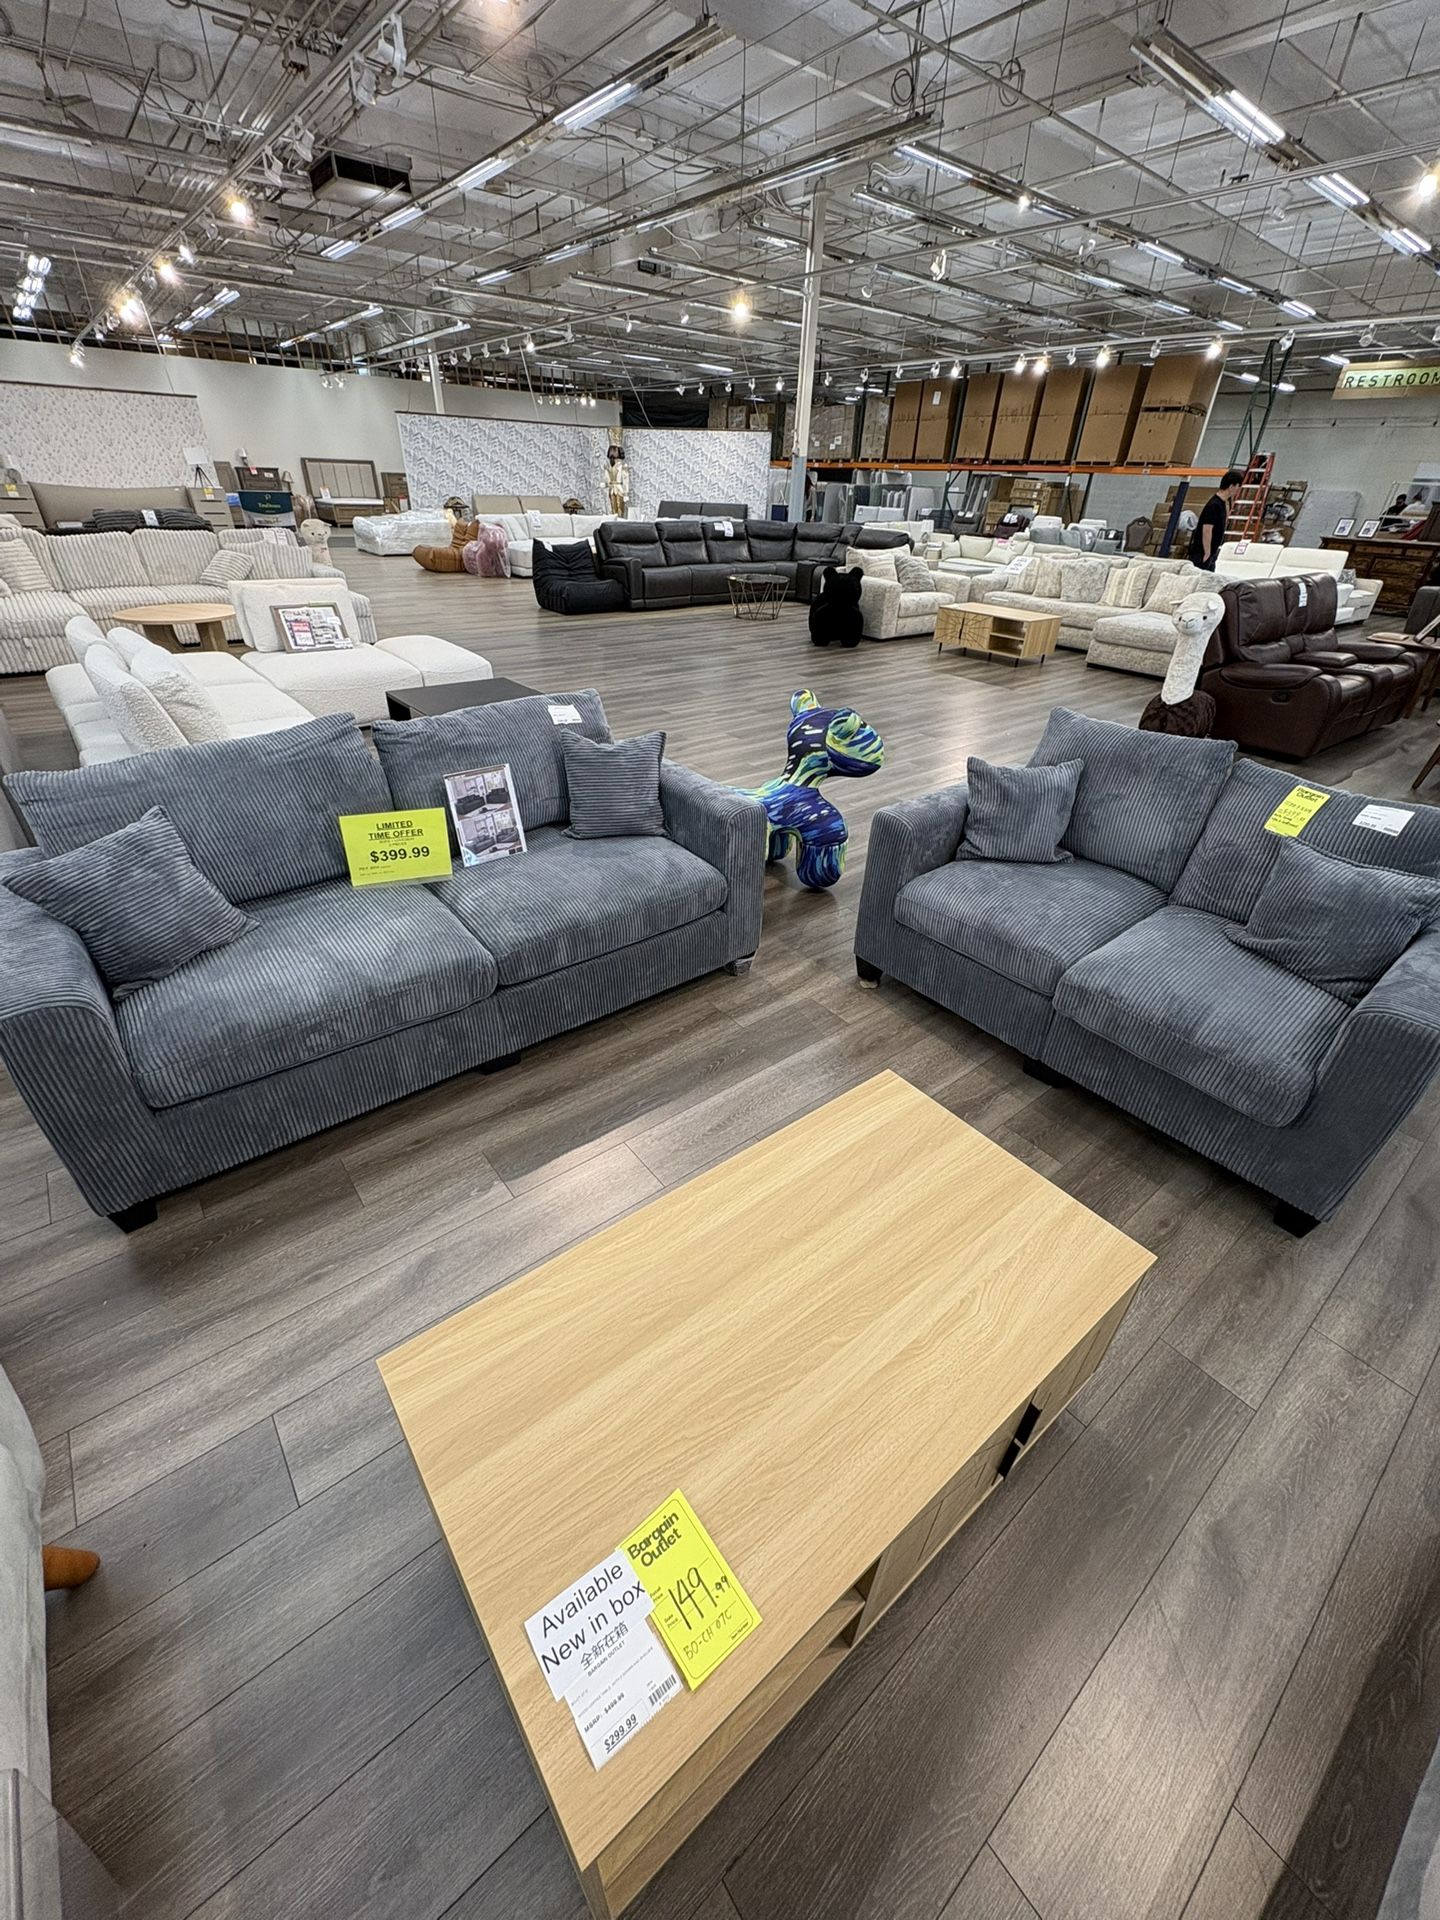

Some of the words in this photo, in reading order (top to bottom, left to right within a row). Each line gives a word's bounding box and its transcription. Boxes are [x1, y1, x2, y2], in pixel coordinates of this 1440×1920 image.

[368, 831, 391, 840] TIME
[393, 829, 424, 838] OFFER
[376, 820, 413, 830] LIMITED
[370, 846, 430, 863] $399.99
[627, 1510, 680, 1560] Bargain
[640, 1527, 682, 1568] Outlet
[541, 1562, 624, 1638] Available
[668, 1567, 731, 1630] 149.99
[541, 1636, 588, 1674] New
[591, 1611, 609, 1633] in
[612, 1580, 646, 1620] box
[580, 1621, 629, 1670] 全新在箱
[587, 1656, 608, 1677] BARGAIN
[607, 1641, 626, 1659] OUTLET
[603, 1713, 638, 1753] $299.99
